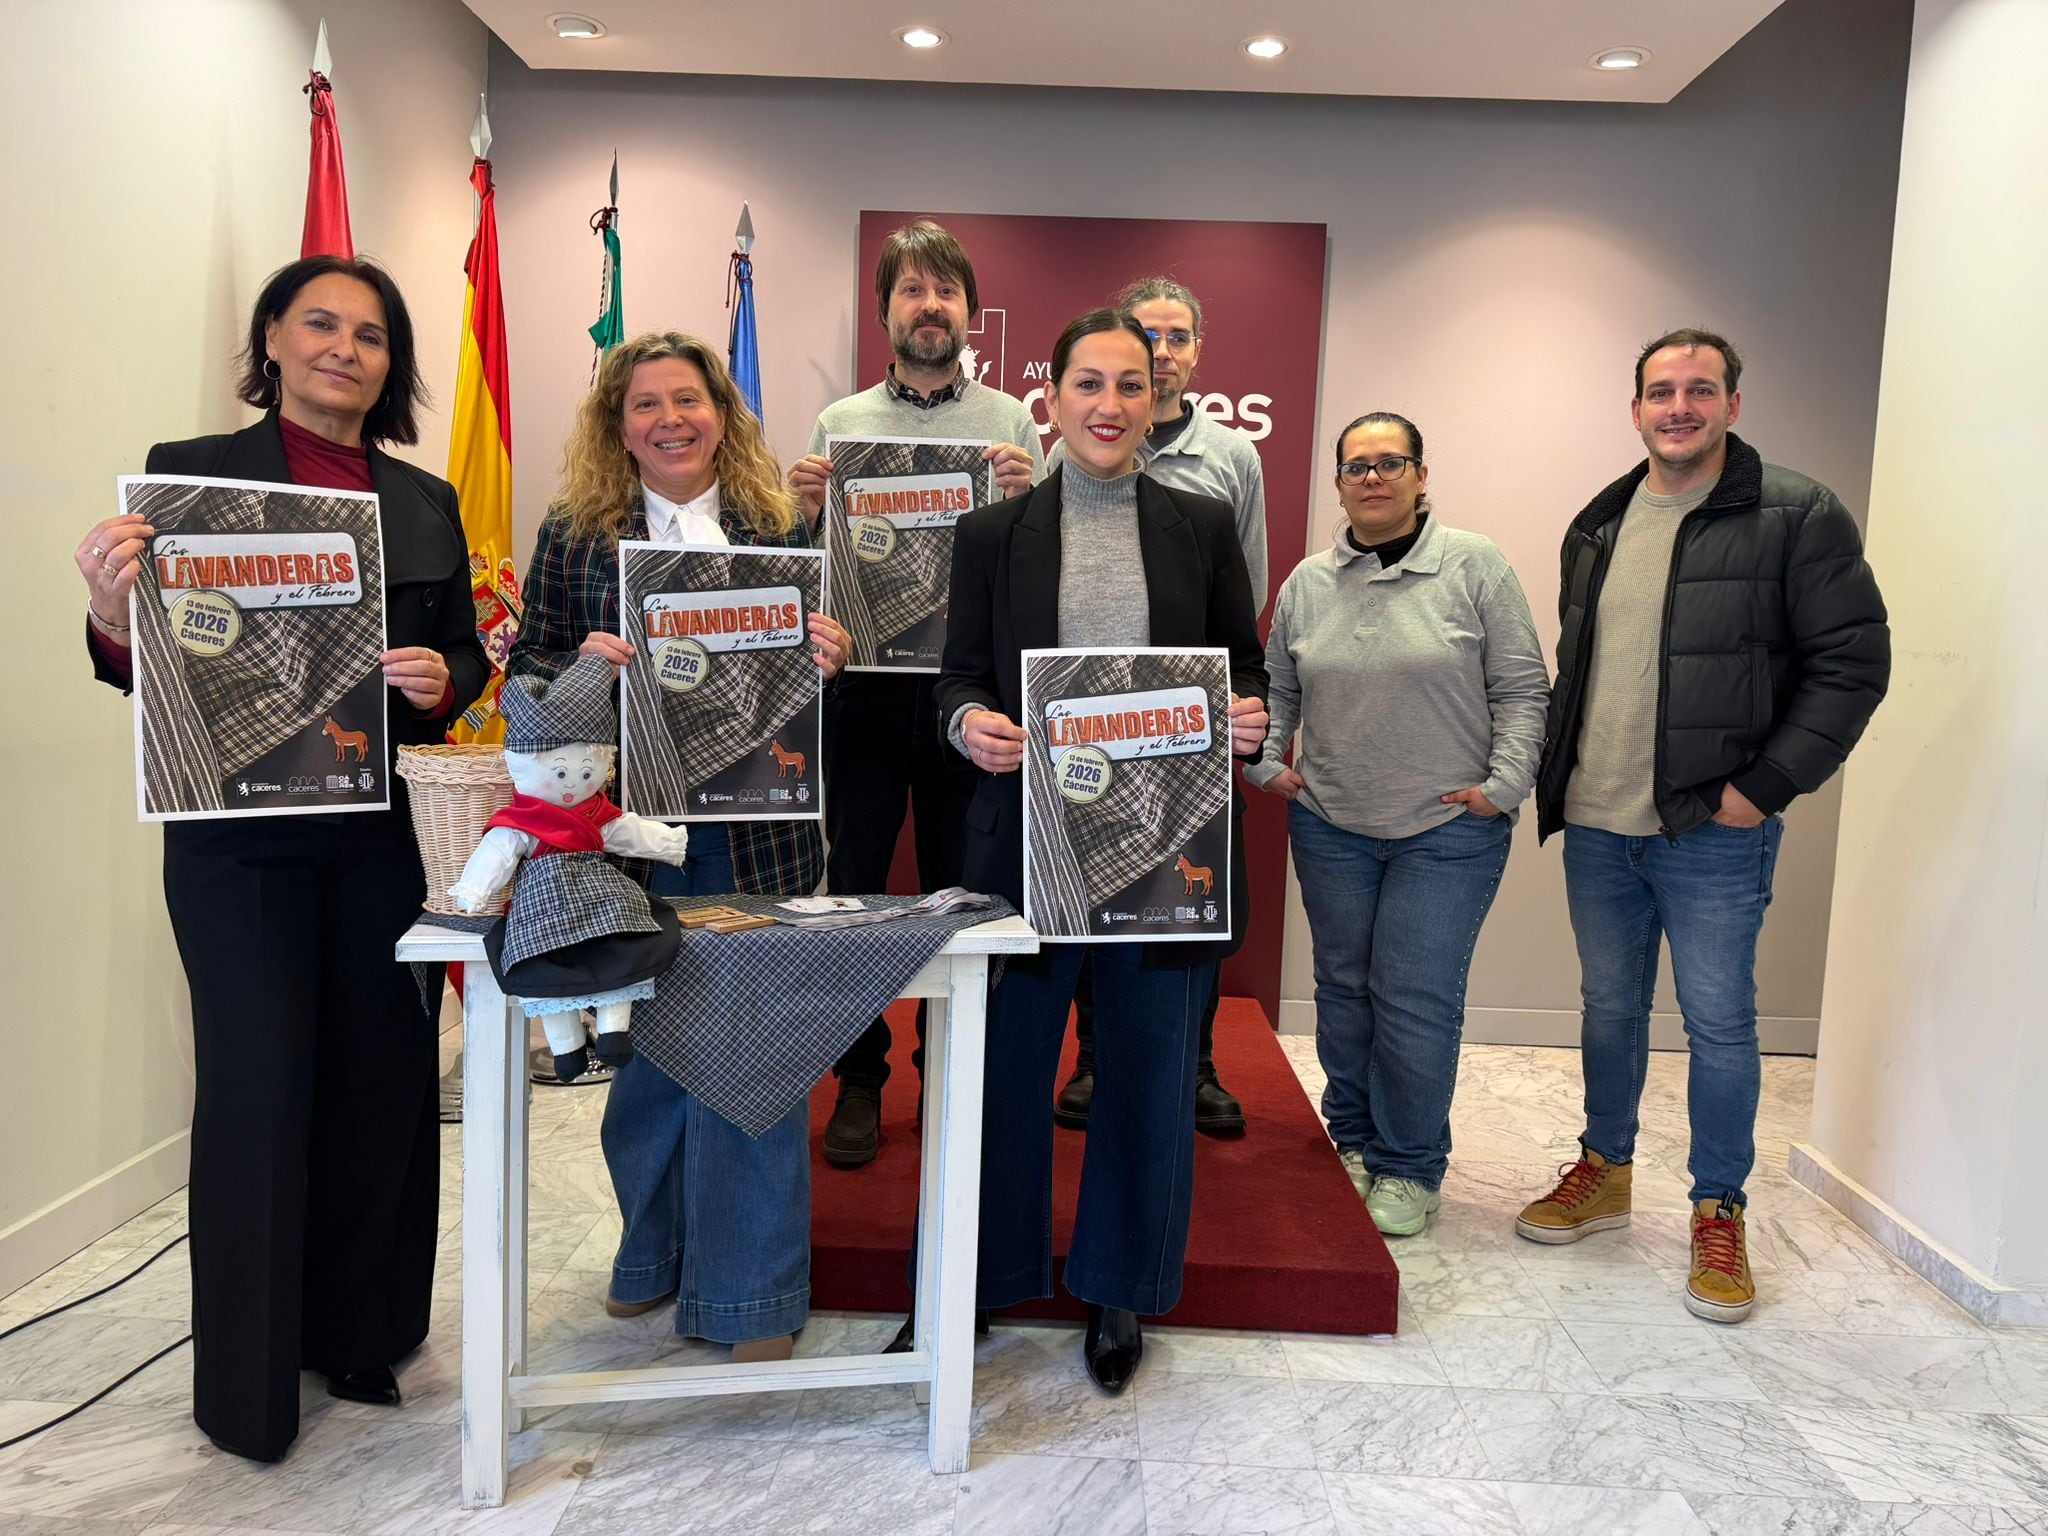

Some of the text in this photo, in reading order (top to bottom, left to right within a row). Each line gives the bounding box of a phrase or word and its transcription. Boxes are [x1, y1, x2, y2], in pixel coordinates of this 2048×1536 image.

[845, 482, 864, 494] Las
[846, 487, 970, 516] LAVANDERAS
[914, 518, 921, 526] y
[926, 514, 936, 522] el
[860, 530, 888, 546] 2026
[154, 540, 189, 557] Las
[157, 553, 354, 589] LAVANDERAS
[270, 584, 356, 605] y el Febrero
[195, 602, 204, 610] de
[205, 604, 232, 616] febrero
[644, 598, 670, 612] Las
[183, 610, 228, 634] 2026
[646, 603, 798, 638] LAVANDERAS
[732, 629, 799, 648] y el Febrero
[664, 654, 698, 673] 2026
[1046, 704, 1072, 720] Las
[1048, 704, 1206, 747] LAVANDERAS
[1135, 734, 1206, 756] y el Febrero
[1066, 763, 1102, 784] 2026
